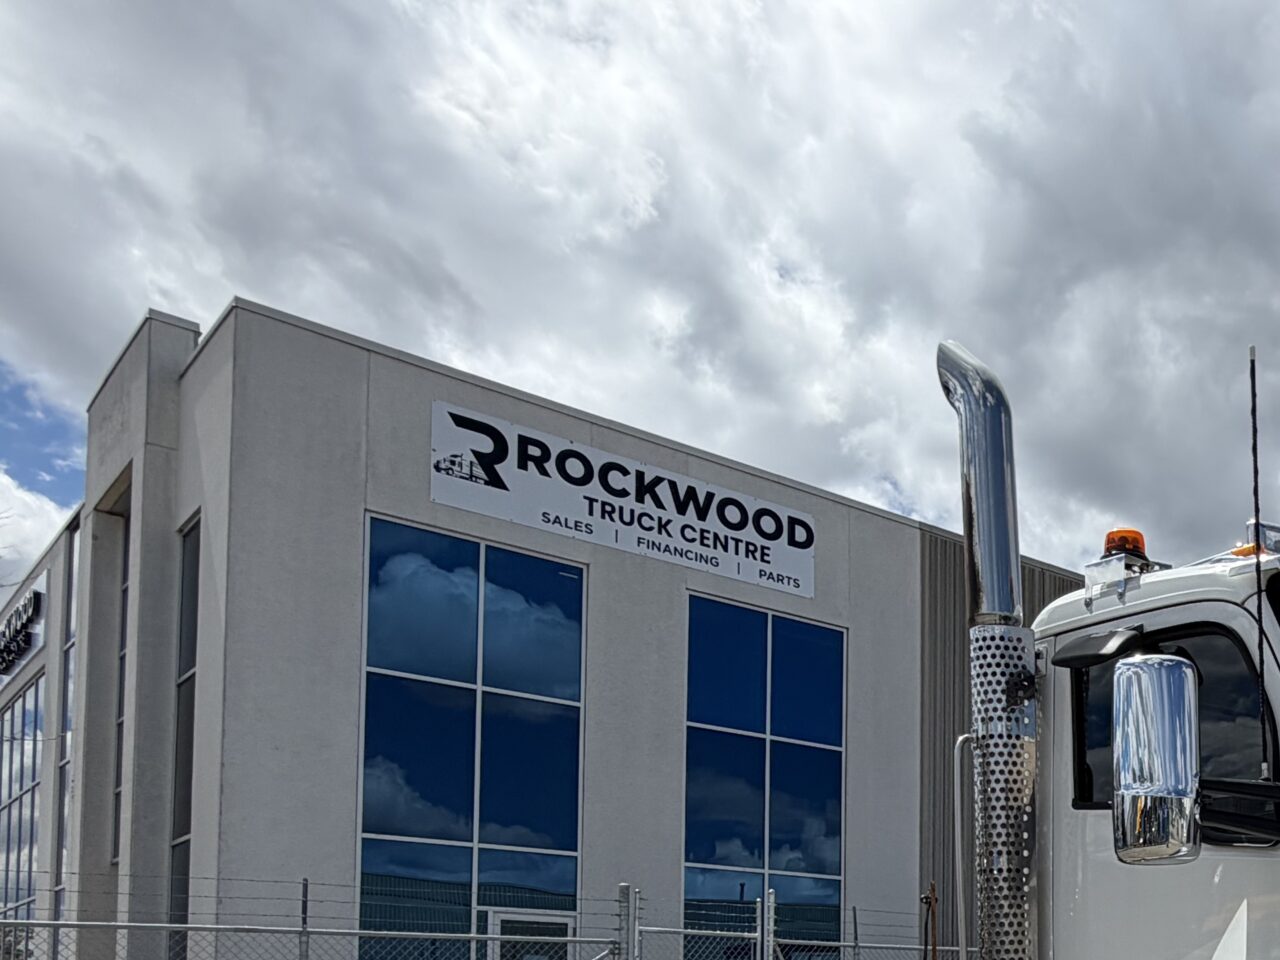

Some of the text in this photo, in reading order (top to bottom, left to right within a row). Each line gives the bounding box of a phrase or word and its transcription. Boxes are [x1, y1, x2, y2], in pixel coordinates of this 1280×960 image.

[516, 433, 815, 550] ROCKWOOD
[583, 495, 771, 565] TRUCK CENTRE
[541, 511, 801, 589] SALES FINANCING PARTS
